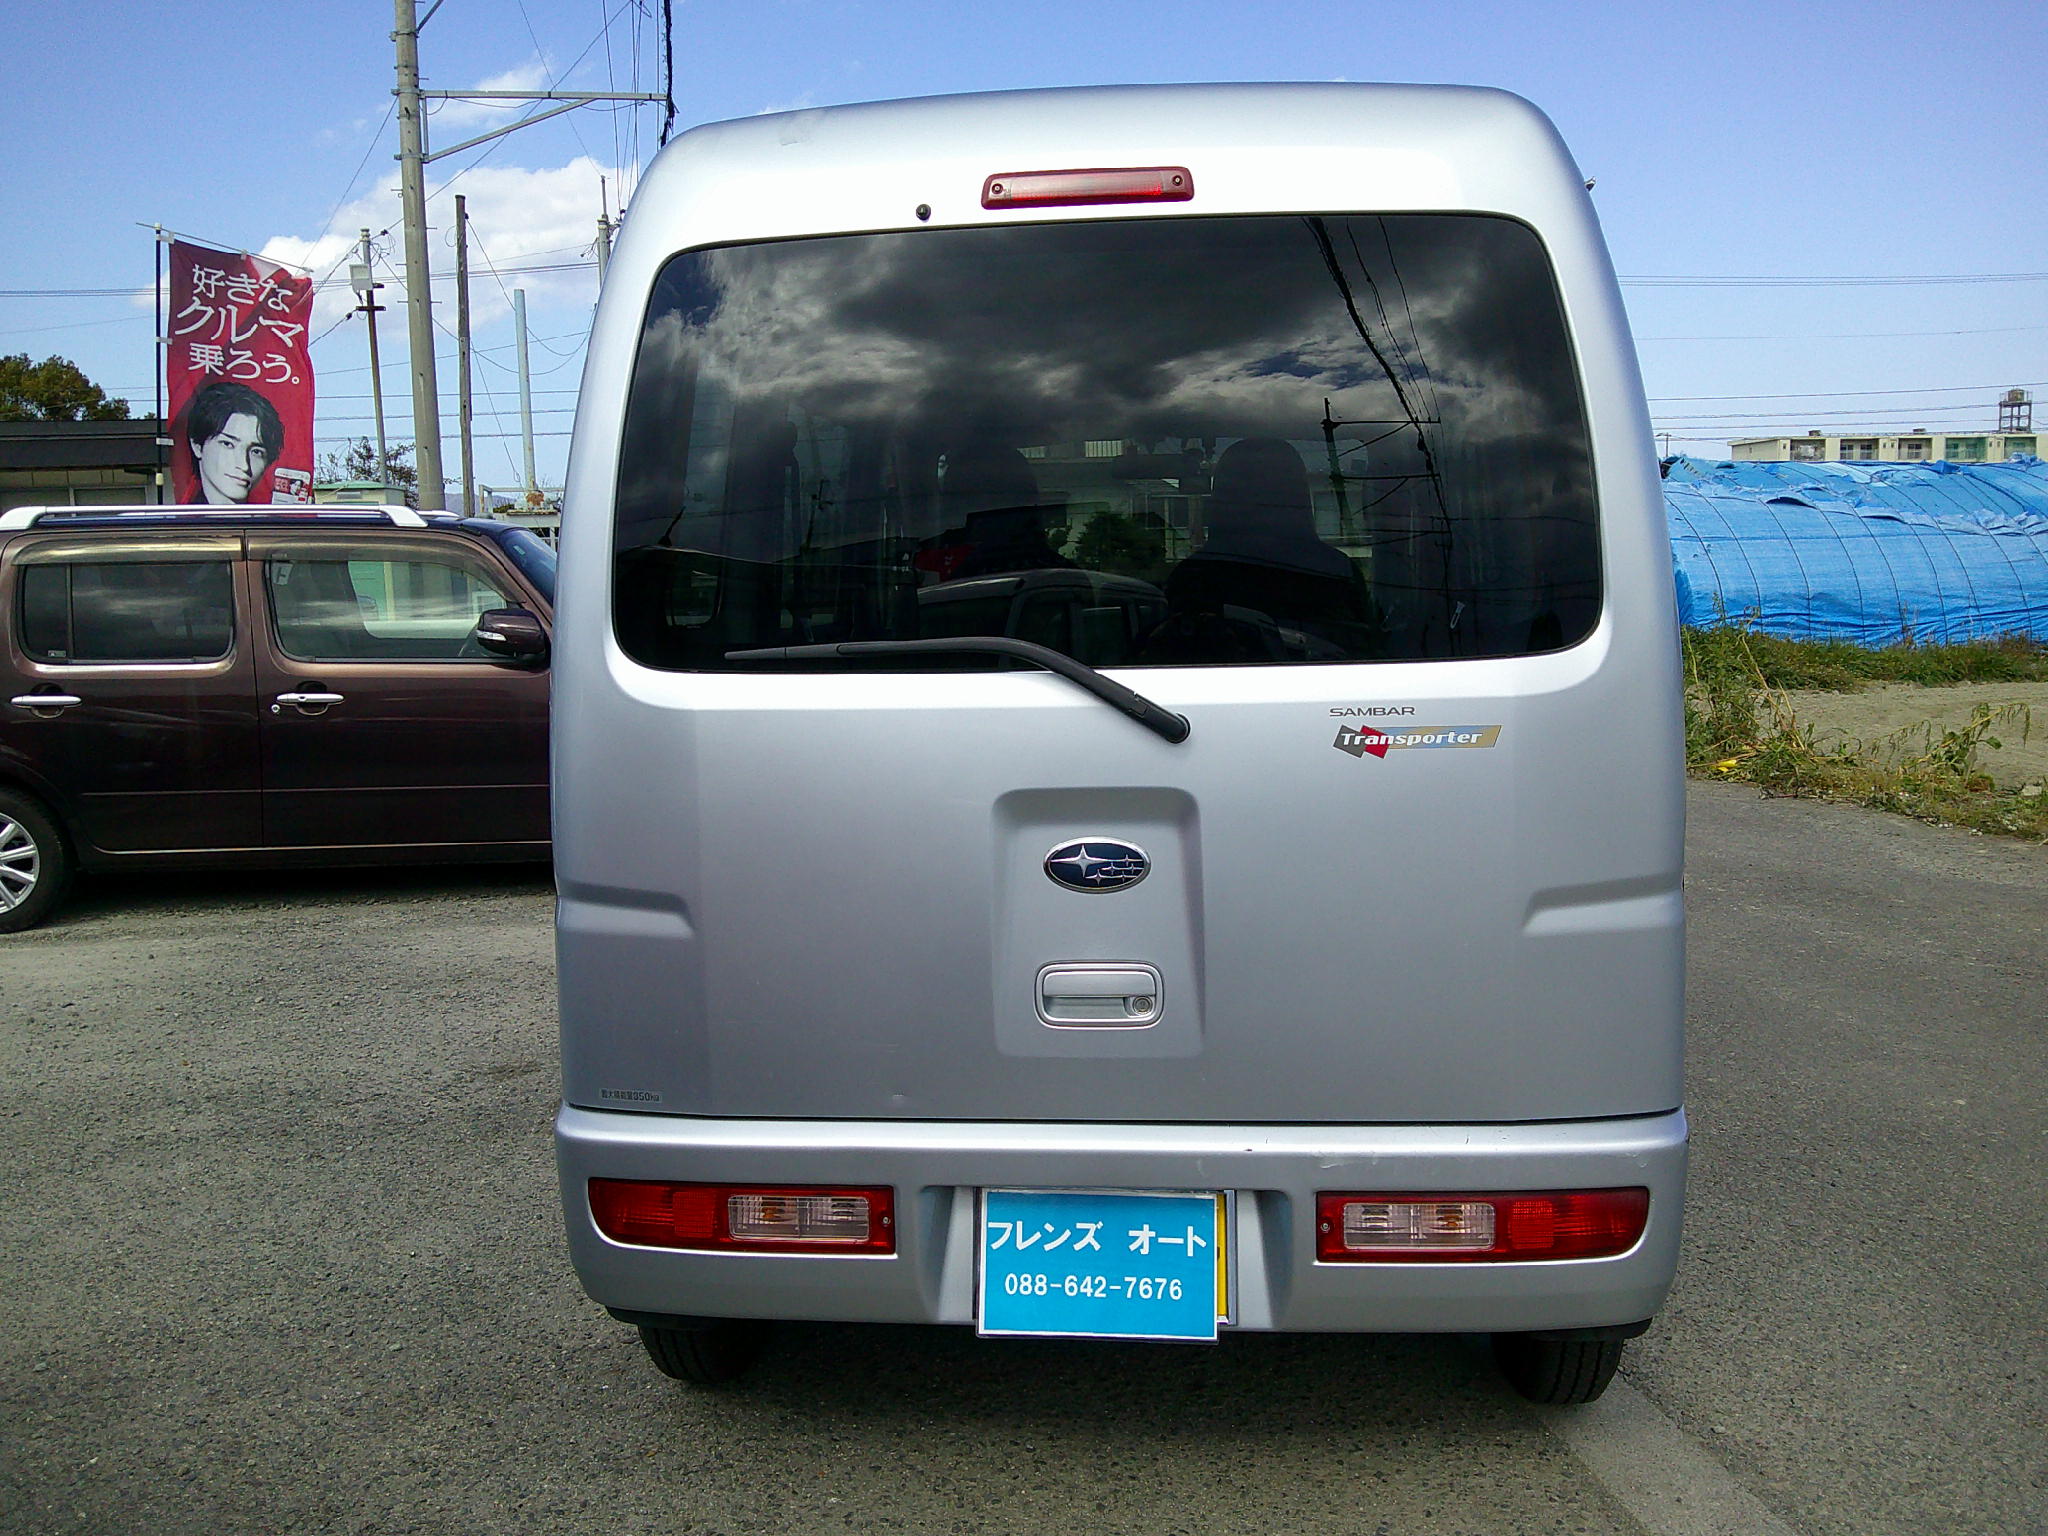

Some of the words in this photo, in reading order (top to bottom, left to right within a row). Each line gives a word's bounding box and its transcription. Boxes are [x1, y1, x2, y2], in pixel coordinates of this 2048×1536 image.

[192, 264, 293, 313] 好きな
[175, 296, 304, 348] クルマ
[188, 342, 301, 385] 乗ろう。
[1329, 706, 1416, 717] SAMBAR
[1341, 731, 1483, 747] Transporter
[987, 1220, 1104, 1252] フレンズ
[1128, 1224, 1208, 1257] オート
[1004, 1273, 1183, 1300] 088-642-7676
